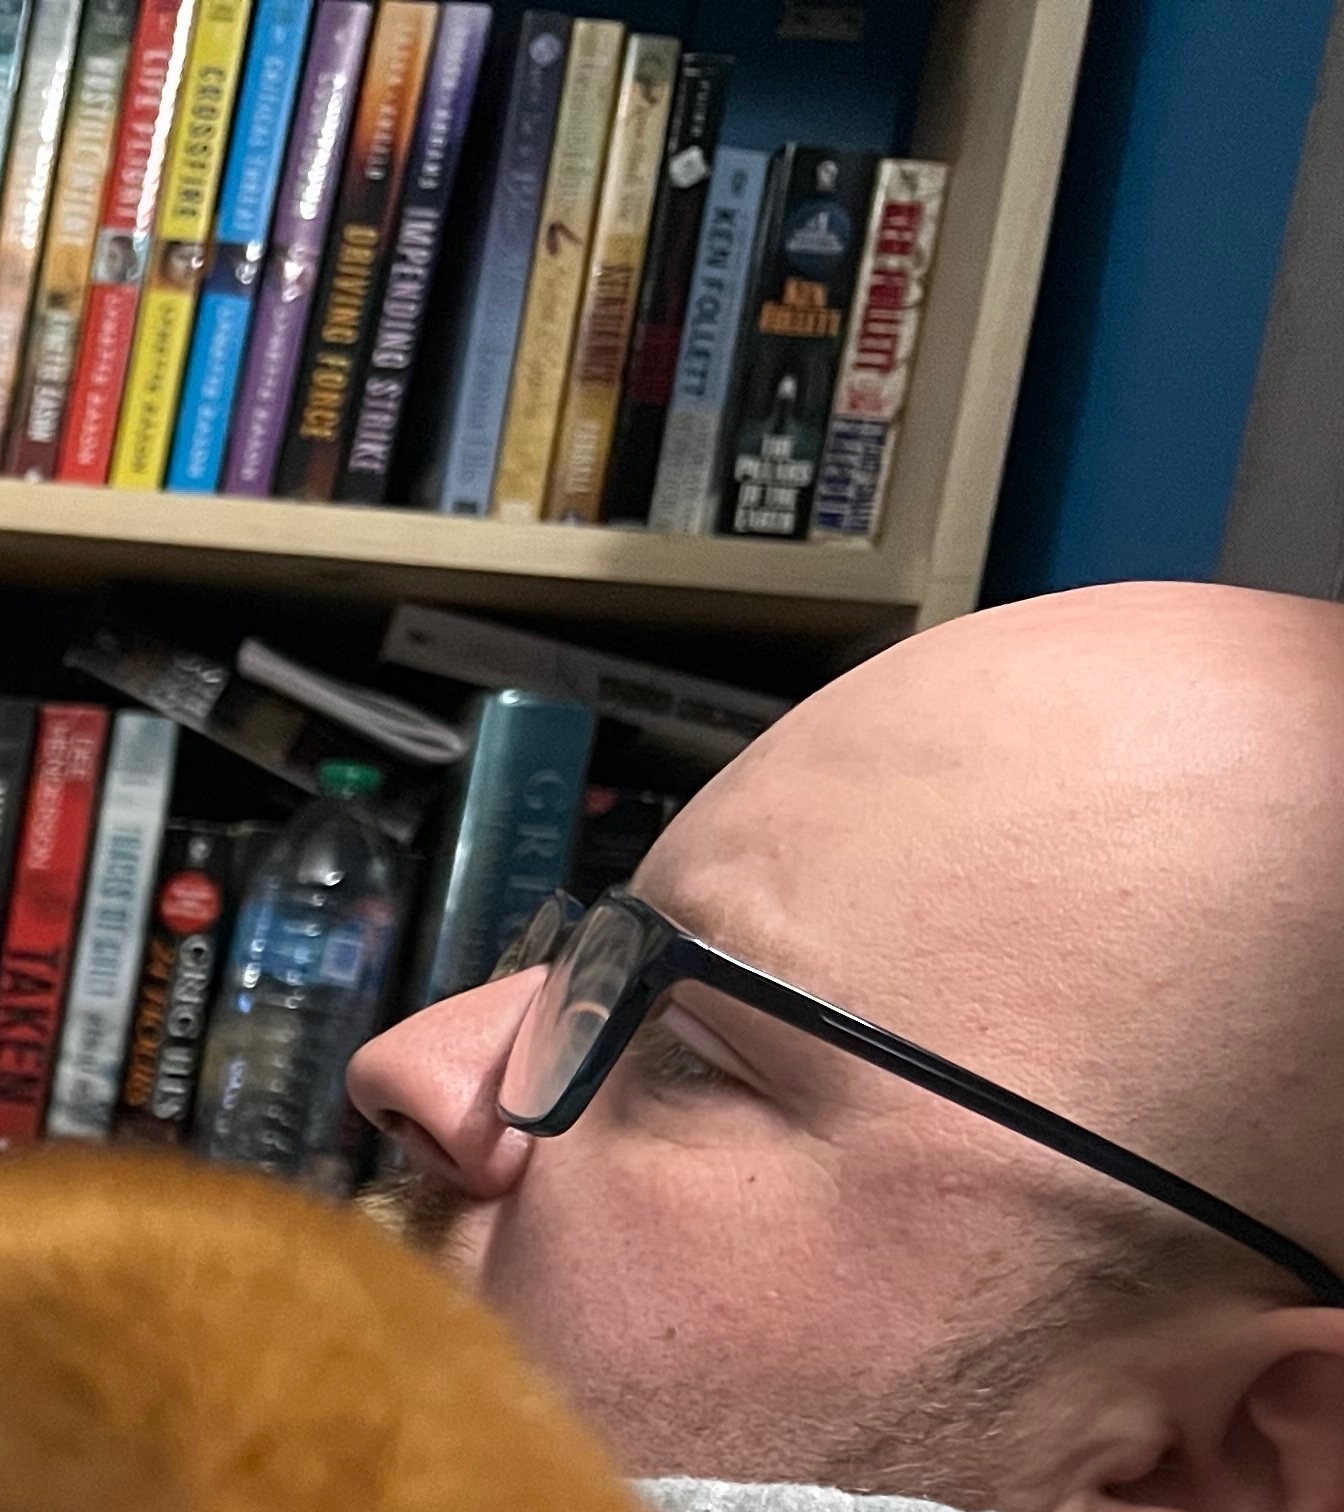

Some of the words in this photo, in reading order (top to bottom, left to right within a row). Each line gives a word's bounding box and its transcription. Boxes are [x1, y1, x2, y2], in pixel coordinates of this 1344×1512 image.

[173, 65, 228, 222] CROSSFIRE
[321, 225, 380, 344] DRIVING
[372, 205, 440, 370] IMPENDING
[708, 207, 738, 267] KEN
[683, 274, 726, 398] FOLLETT
[300, 352, 353, 442] FORCE
[348, 377, 405, 475] STRIKE
[23, 720, 71, 871] HENDERSON
